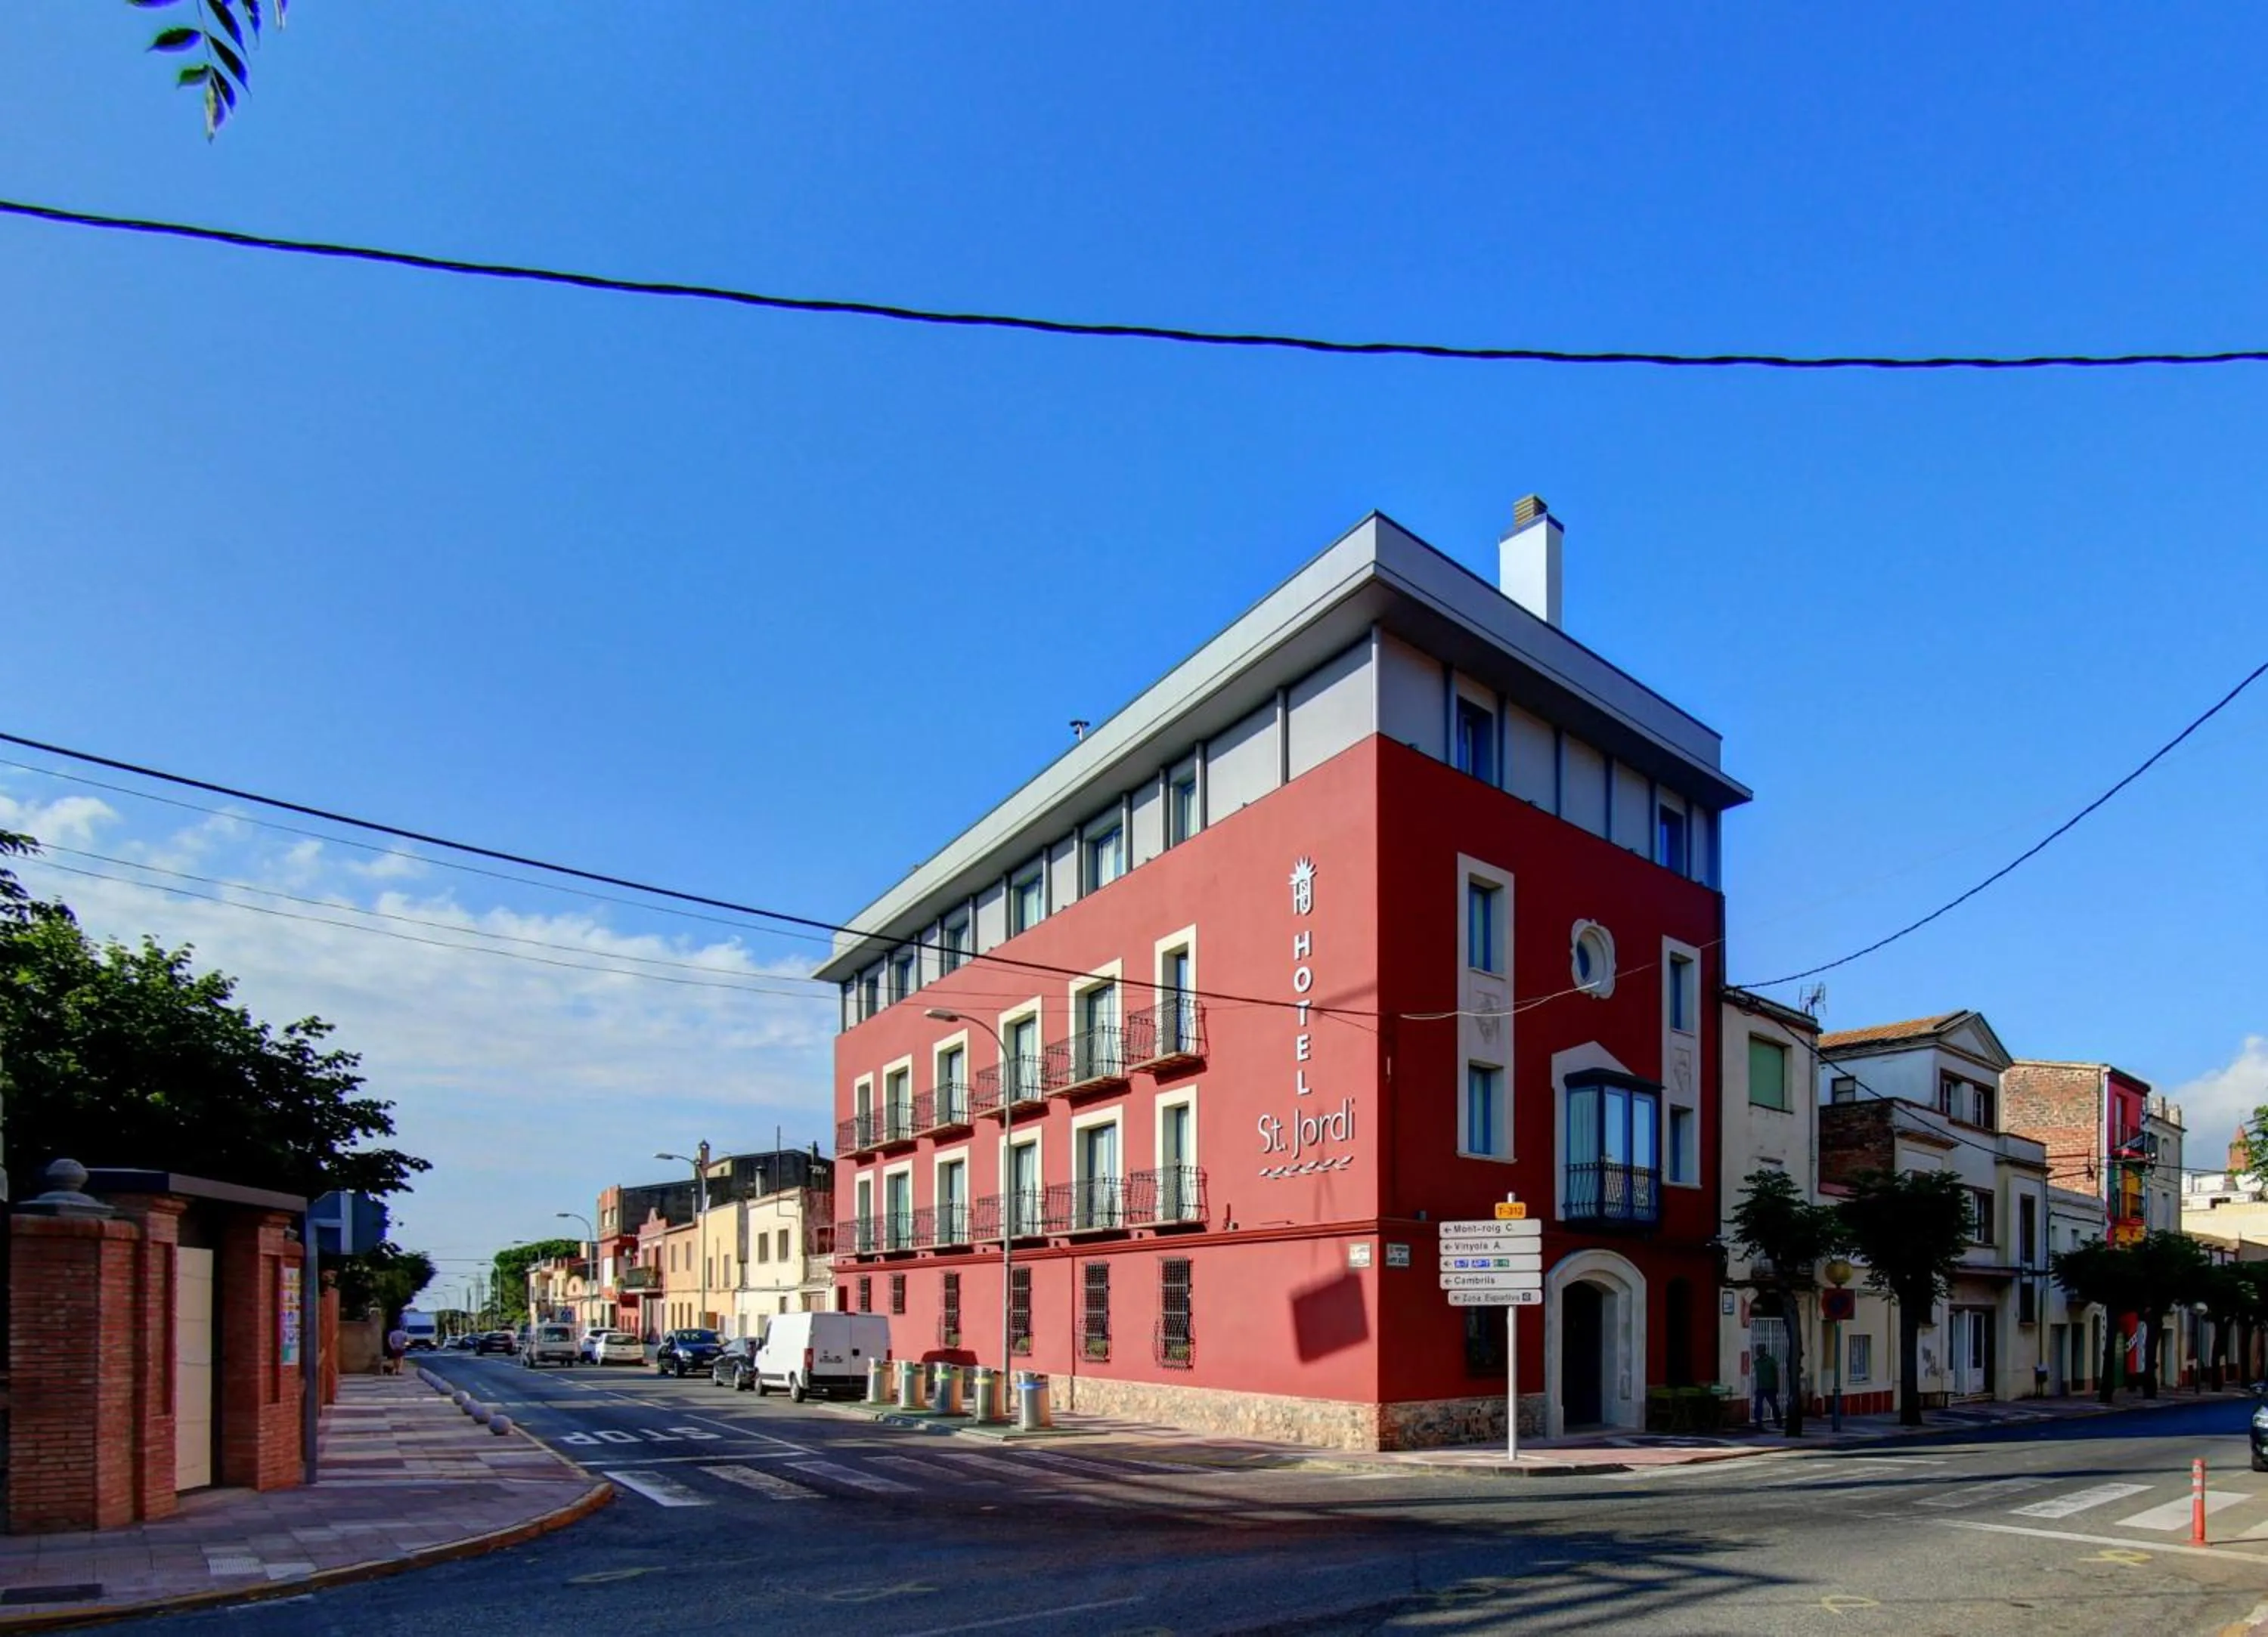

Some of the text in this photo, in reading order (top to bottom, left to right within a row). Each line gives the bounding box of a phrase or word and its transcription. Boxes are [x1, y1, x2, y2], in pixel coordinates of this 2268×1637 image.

[1294, 930, 1312, 1095] HOTEL
[1258, 1097, 1355, 1159] St. Jordi
[1454, 1224, 1501, 1233] Mont-roig
[561, 1427, 722, 1444] STOP
